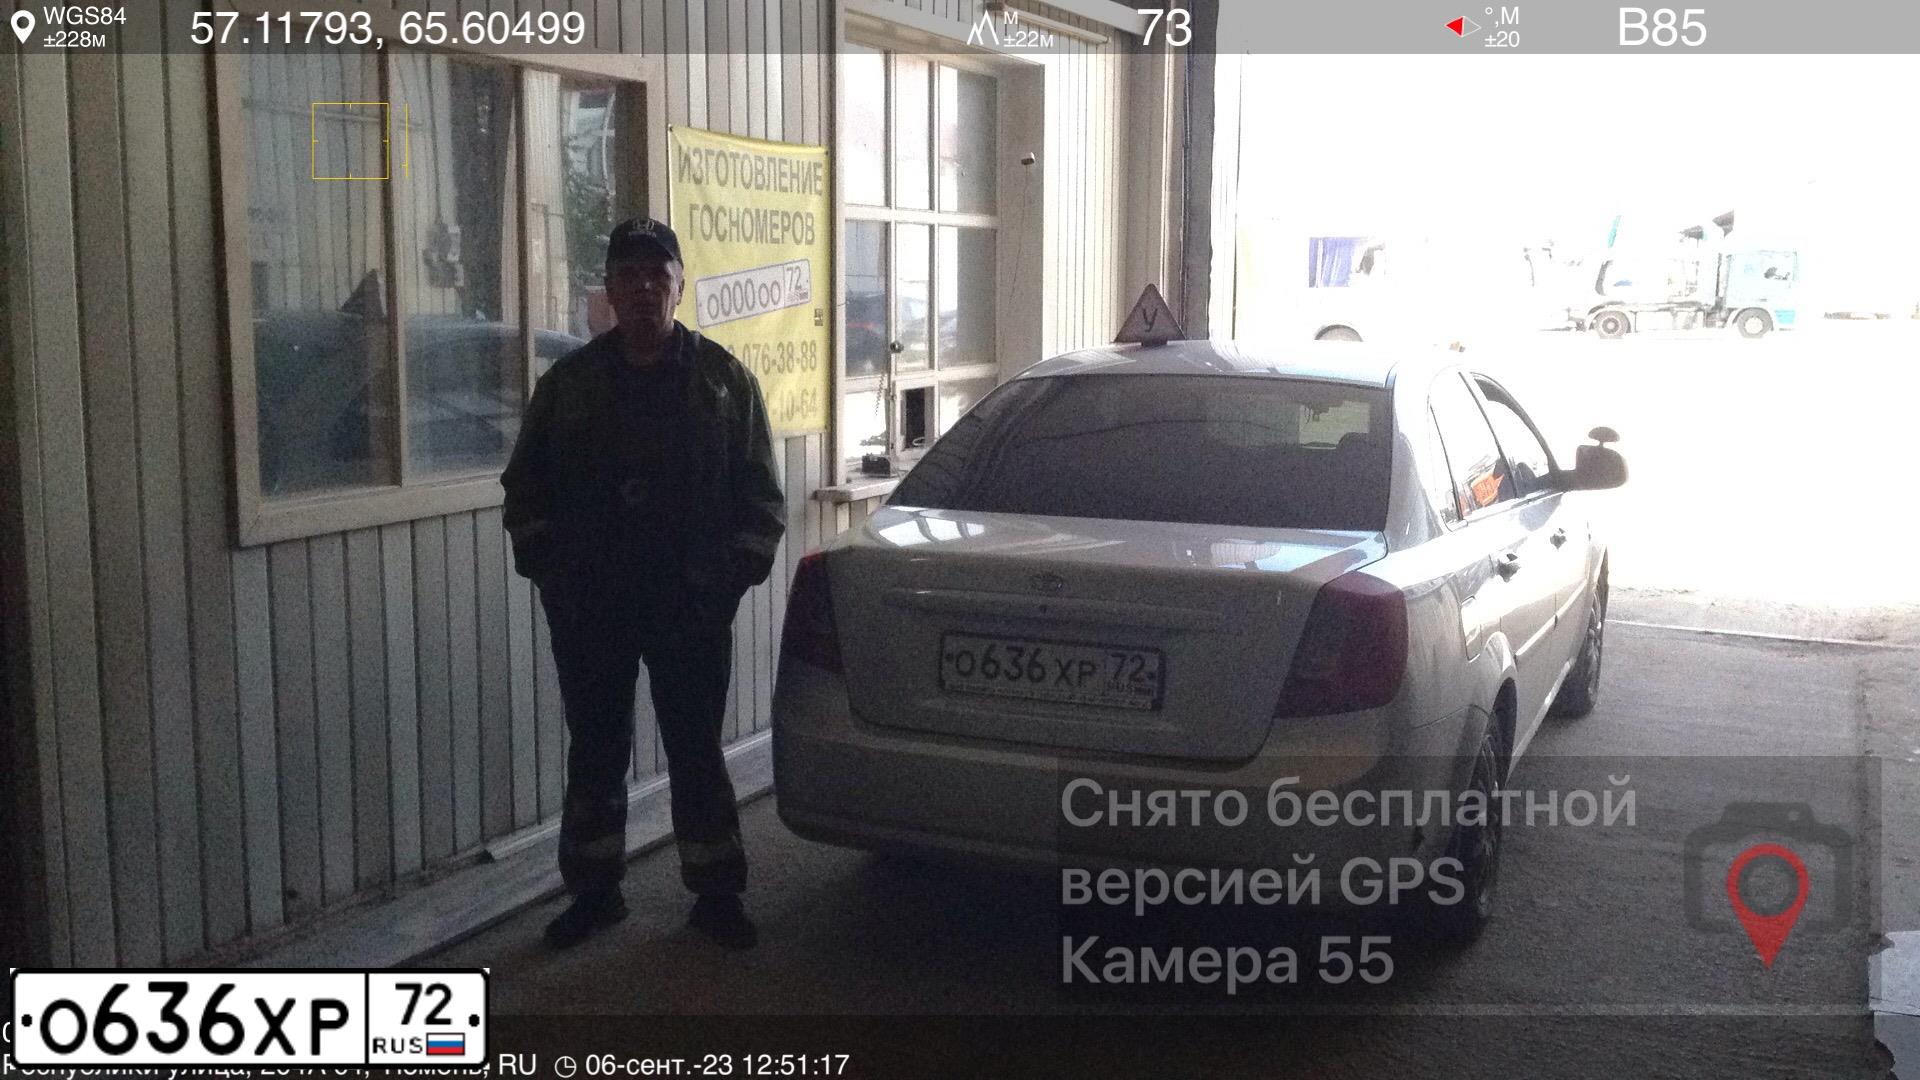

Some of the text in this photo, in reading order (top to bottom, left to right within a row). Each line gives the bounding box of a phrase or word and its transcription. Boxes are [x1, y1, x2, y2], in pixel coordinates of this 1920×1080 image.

[677, 145, 824, 196] ИЗГОТОВЛЕНИЕ
[689, 203, 816, 246] ГОСНОМЕРОВ
[1110, 651, 1146, 682] 72
